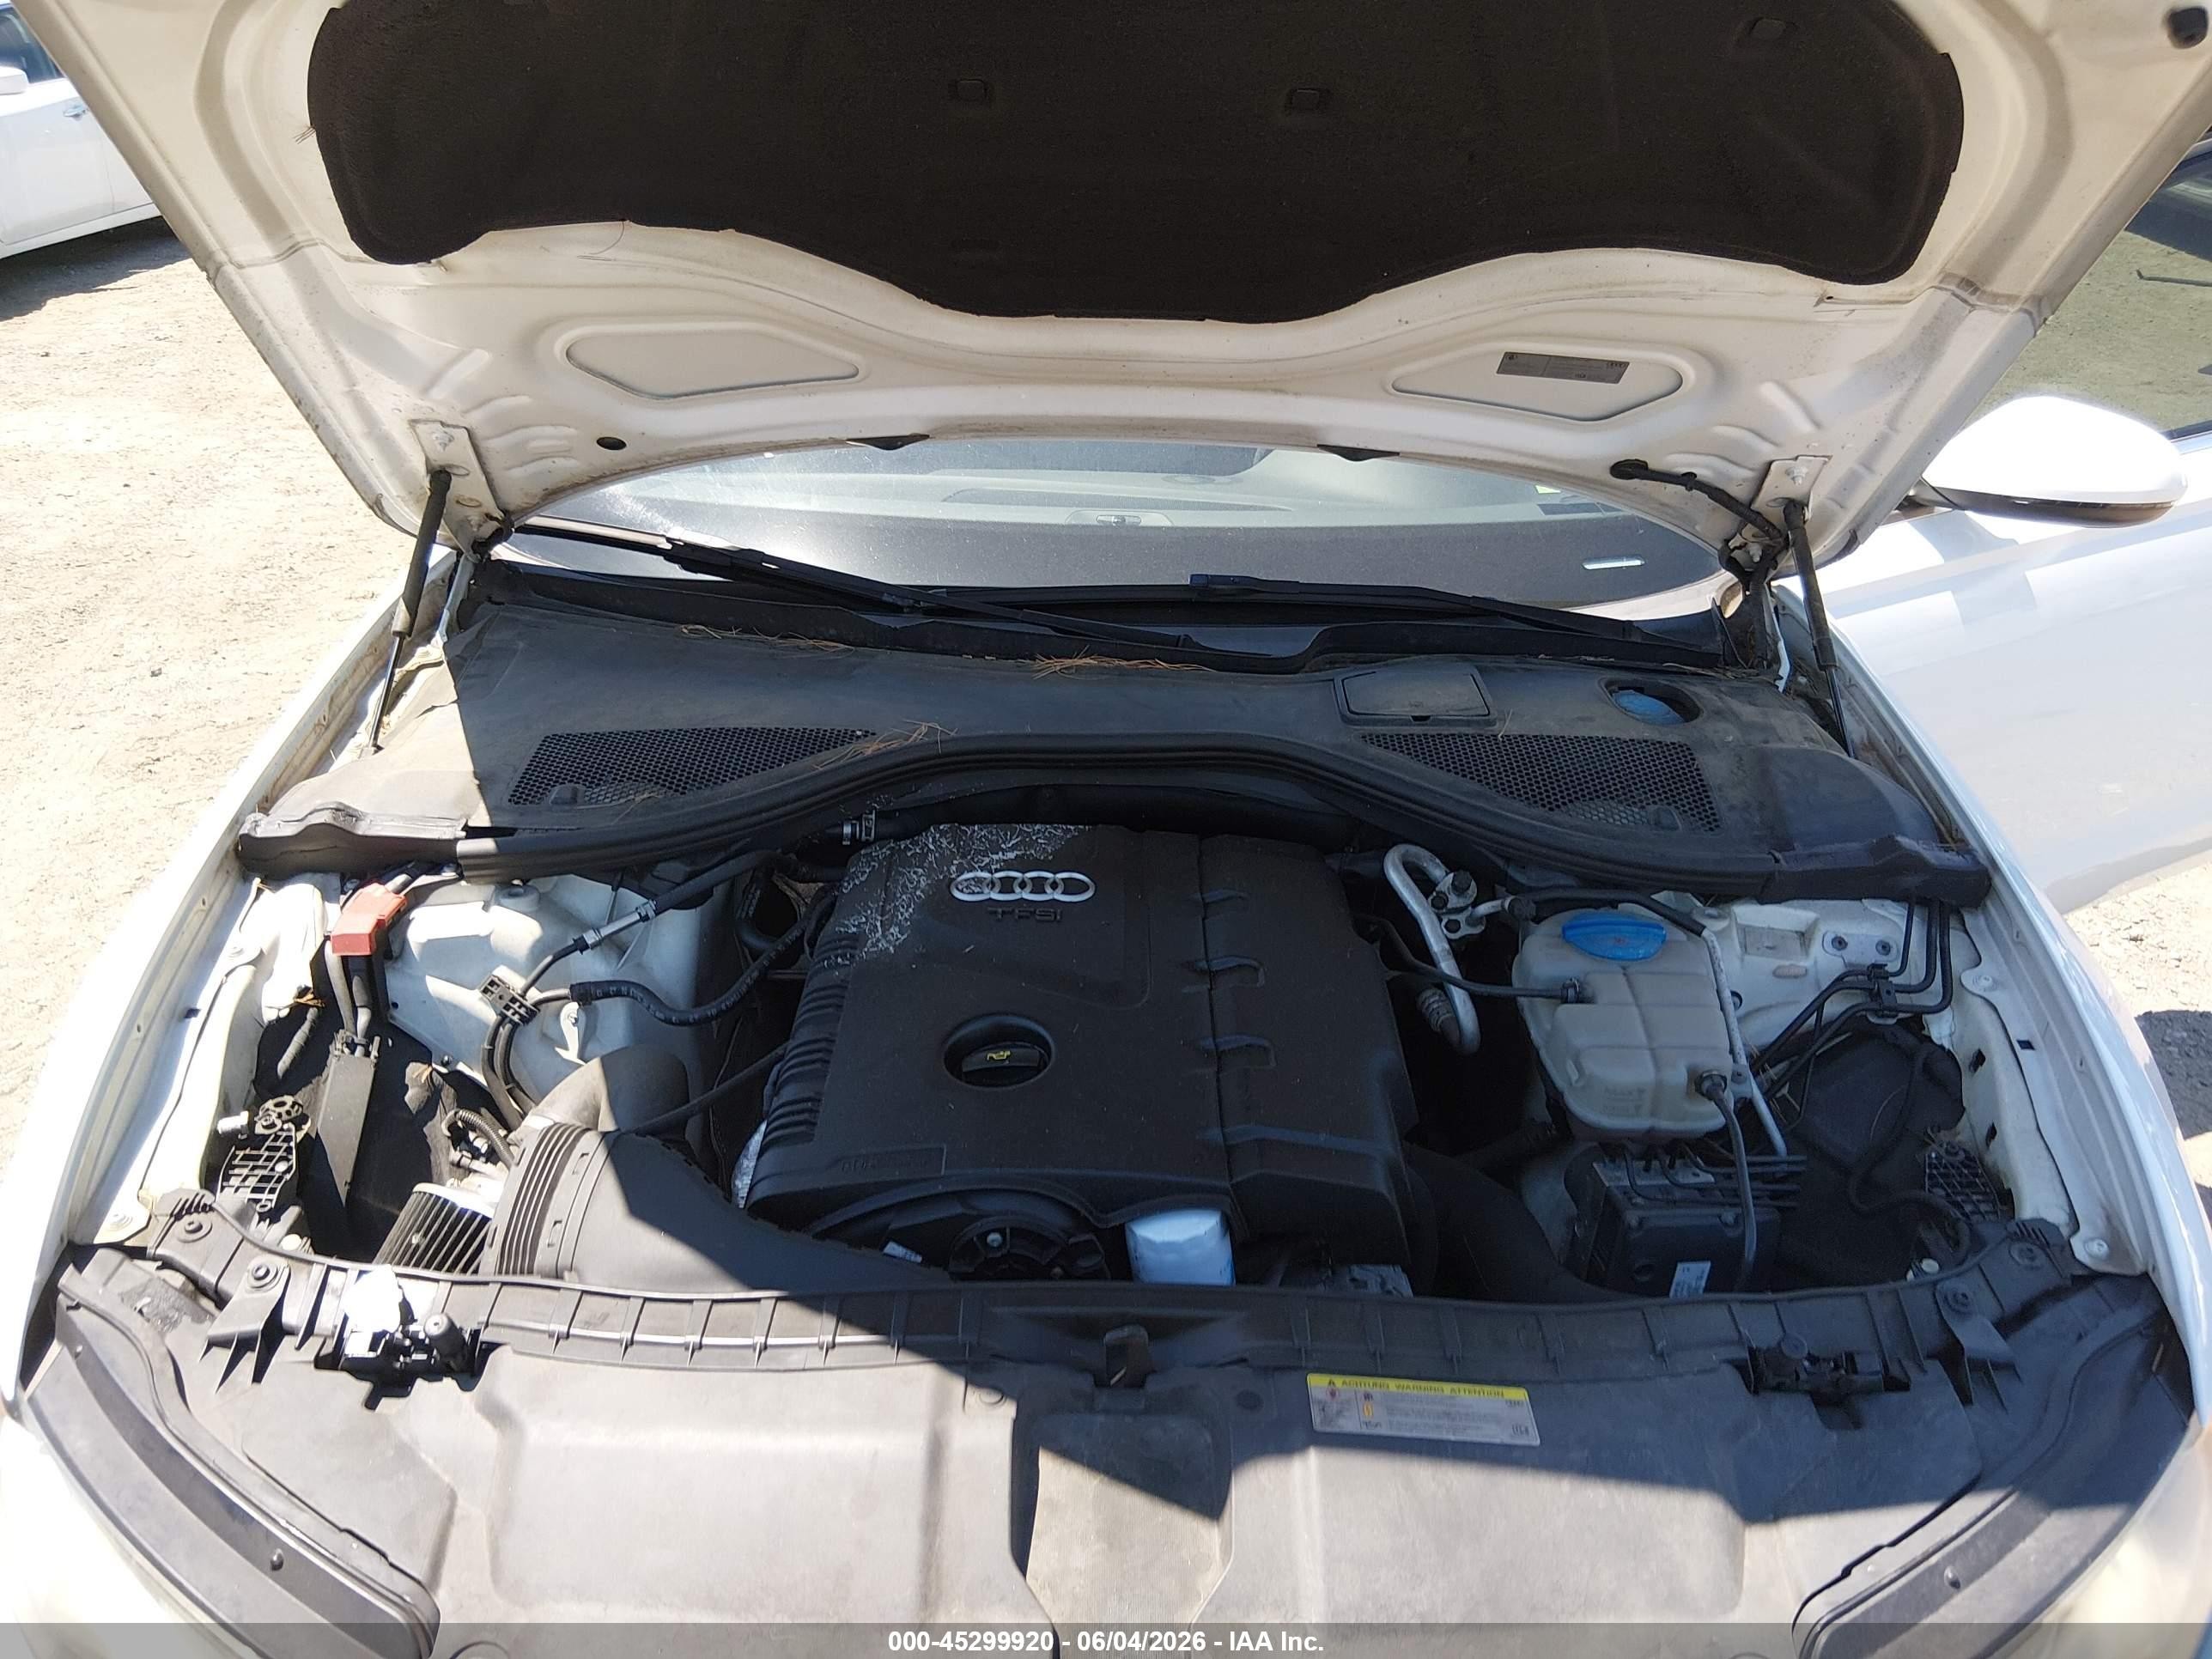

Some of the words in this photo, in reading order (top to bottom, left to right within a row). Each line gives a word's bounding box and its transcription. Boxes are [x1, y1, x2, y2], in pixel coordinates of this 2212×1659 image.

[988, 908, 1063, 921] TFSI
[1341, 1379, 1390, 1390] ACHTUNG
[1395, 1383, 1444, 1394] WARNING
[1449, 1387, 1504, 1398] ATTENTION
